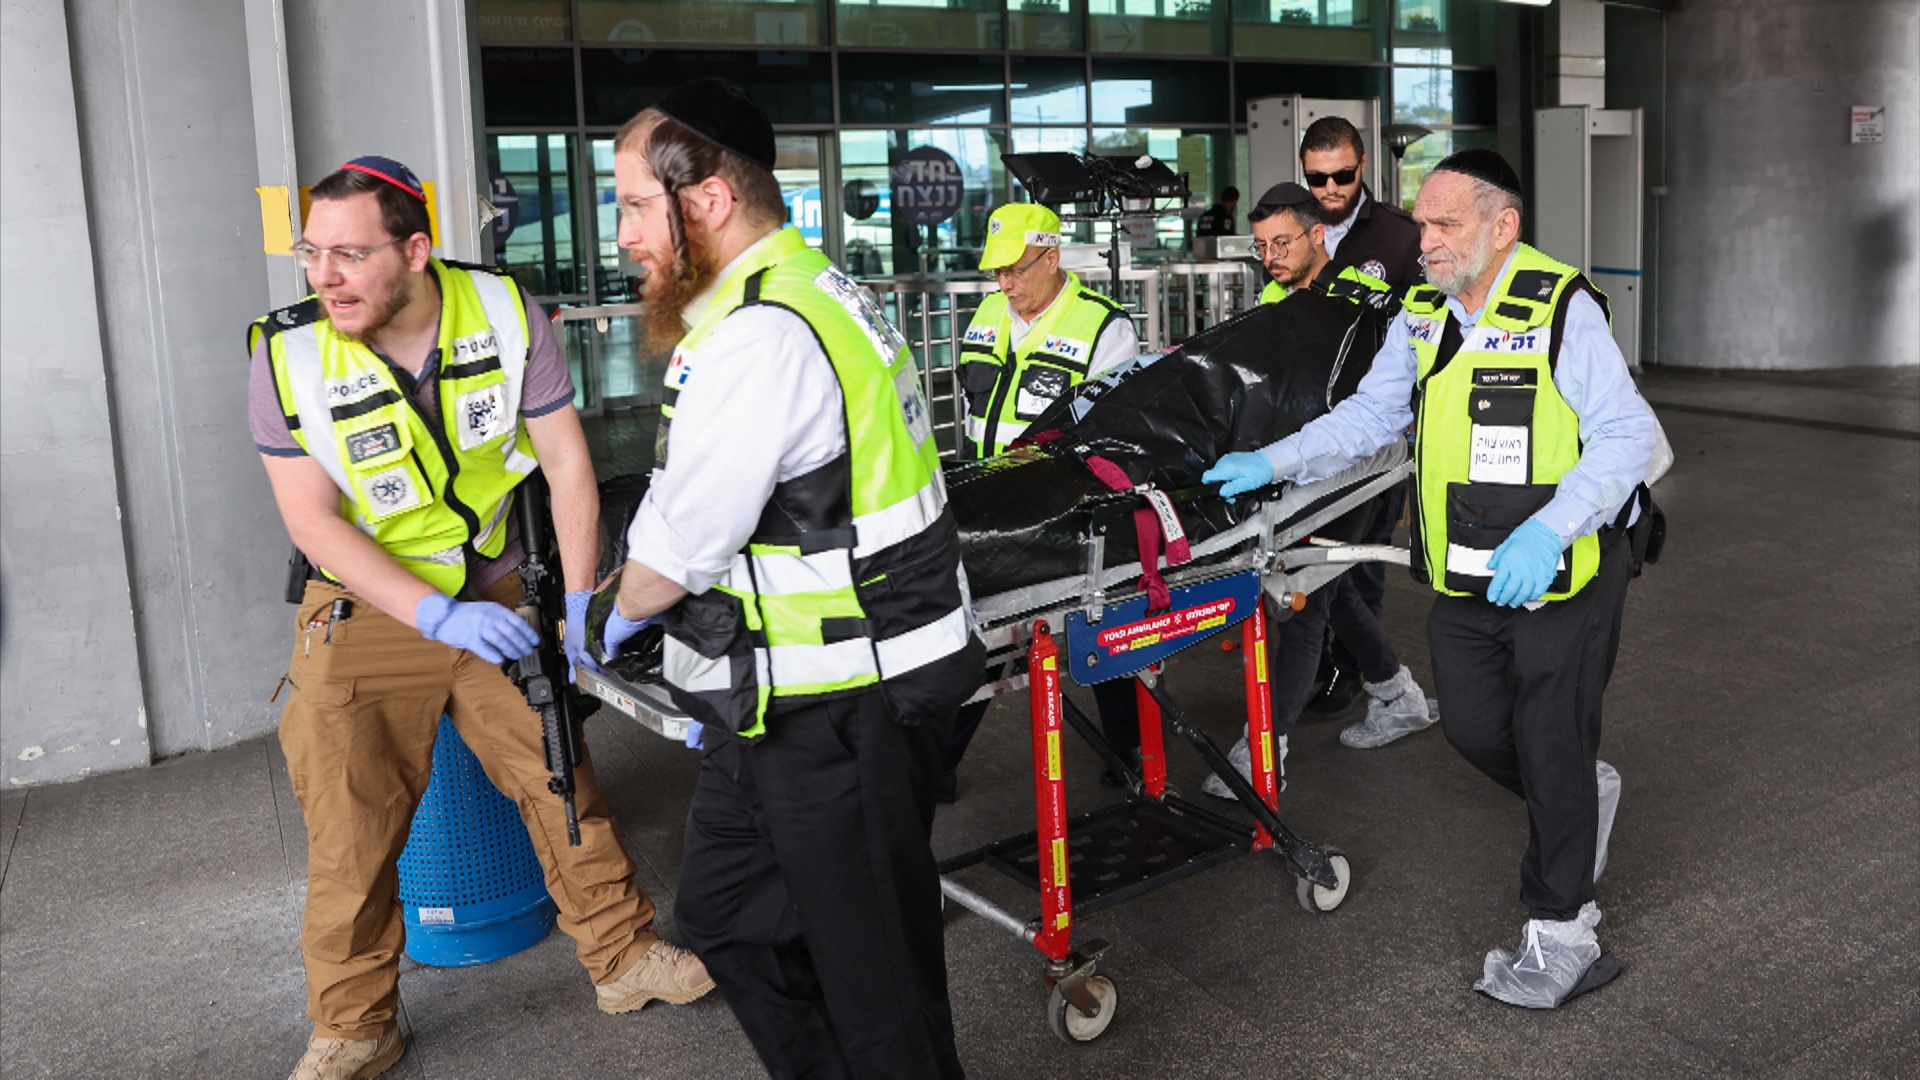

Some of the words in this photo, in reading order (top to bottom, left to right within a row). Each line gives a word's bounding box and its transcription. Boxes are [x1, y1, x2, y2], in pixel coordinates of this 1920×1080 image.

[909, 160, 956, 183] יחד
[897, 185, 958, 208] ננצח
[328, 373, 378, 398] POLCE
